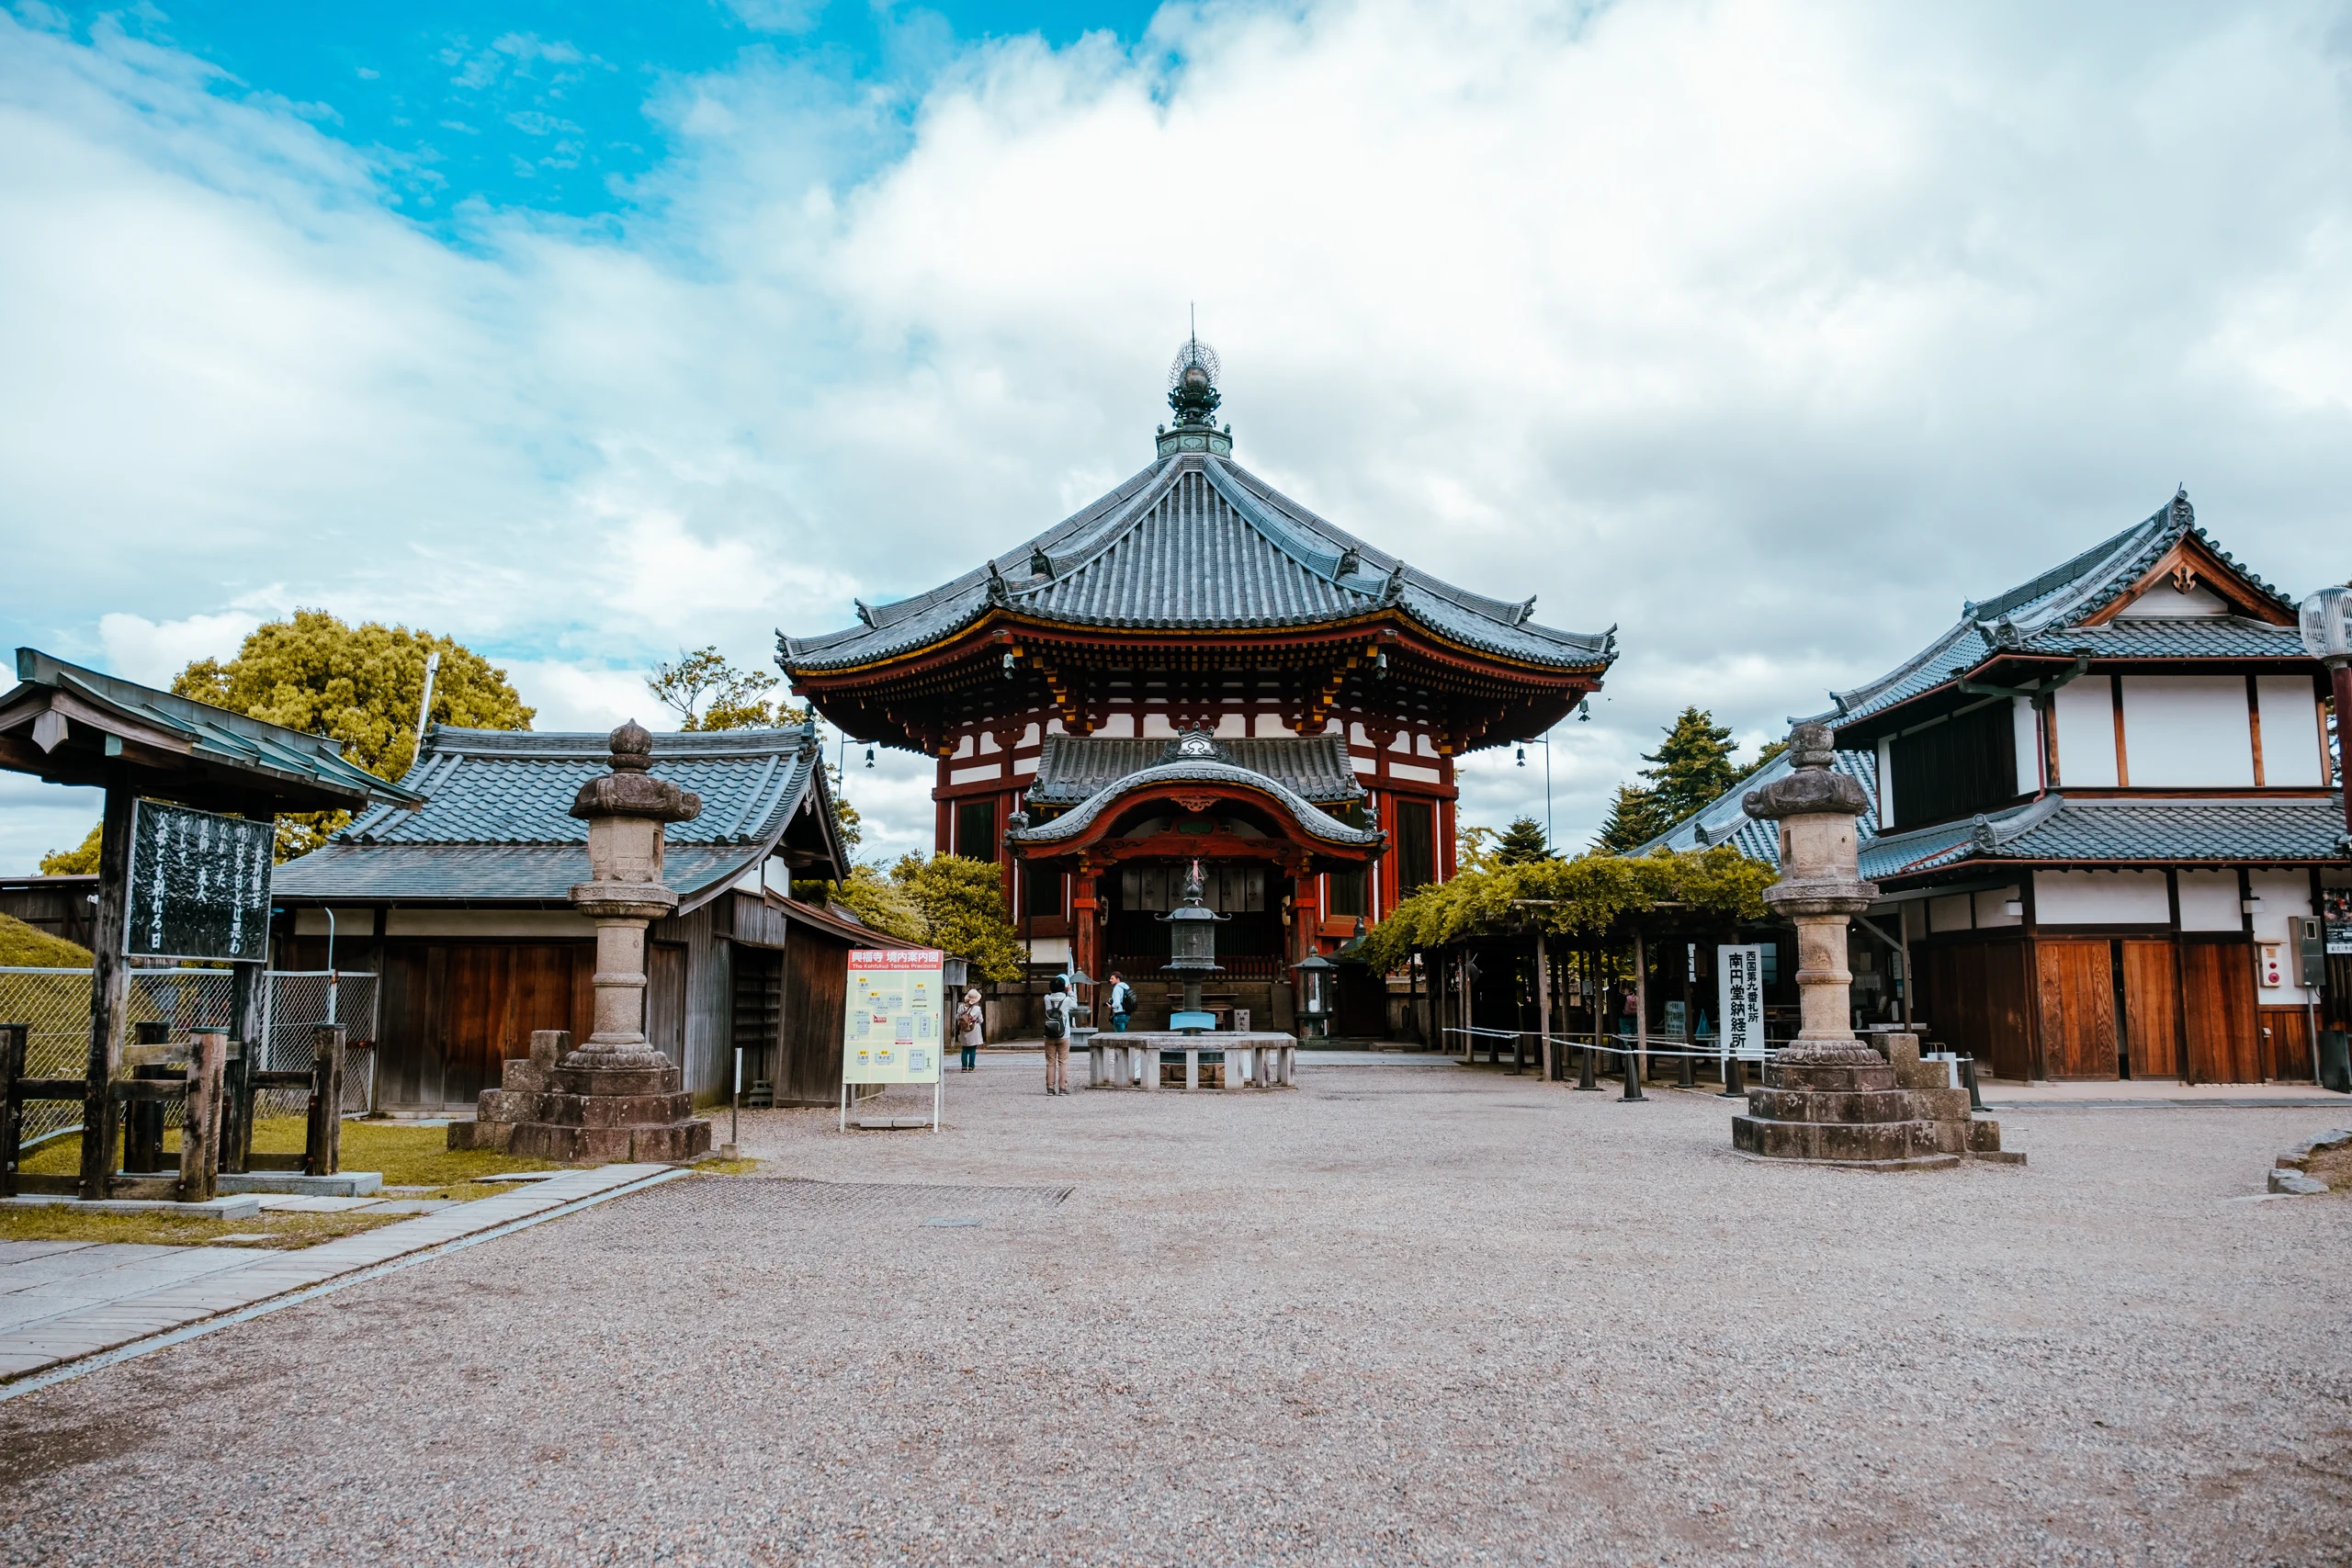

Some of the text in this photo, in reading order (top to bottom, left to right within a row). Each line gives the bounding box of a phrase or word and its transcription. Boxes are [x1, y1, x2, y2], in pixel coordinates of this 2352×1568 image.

[179, 815, 191, 867] そして
[214, 822, 228, 888] なかった
[151, 811, 170, 950] 父母とも別れる日
[229, 826, 247, 954] 昨日今日とは思わ
[852, 952, 939, 963] 興福寺 境内案内図
[1746, 951, 1758, 1023] 西国第九番札所
[1728, 952, 1747, 1048] 南円堂納経所
